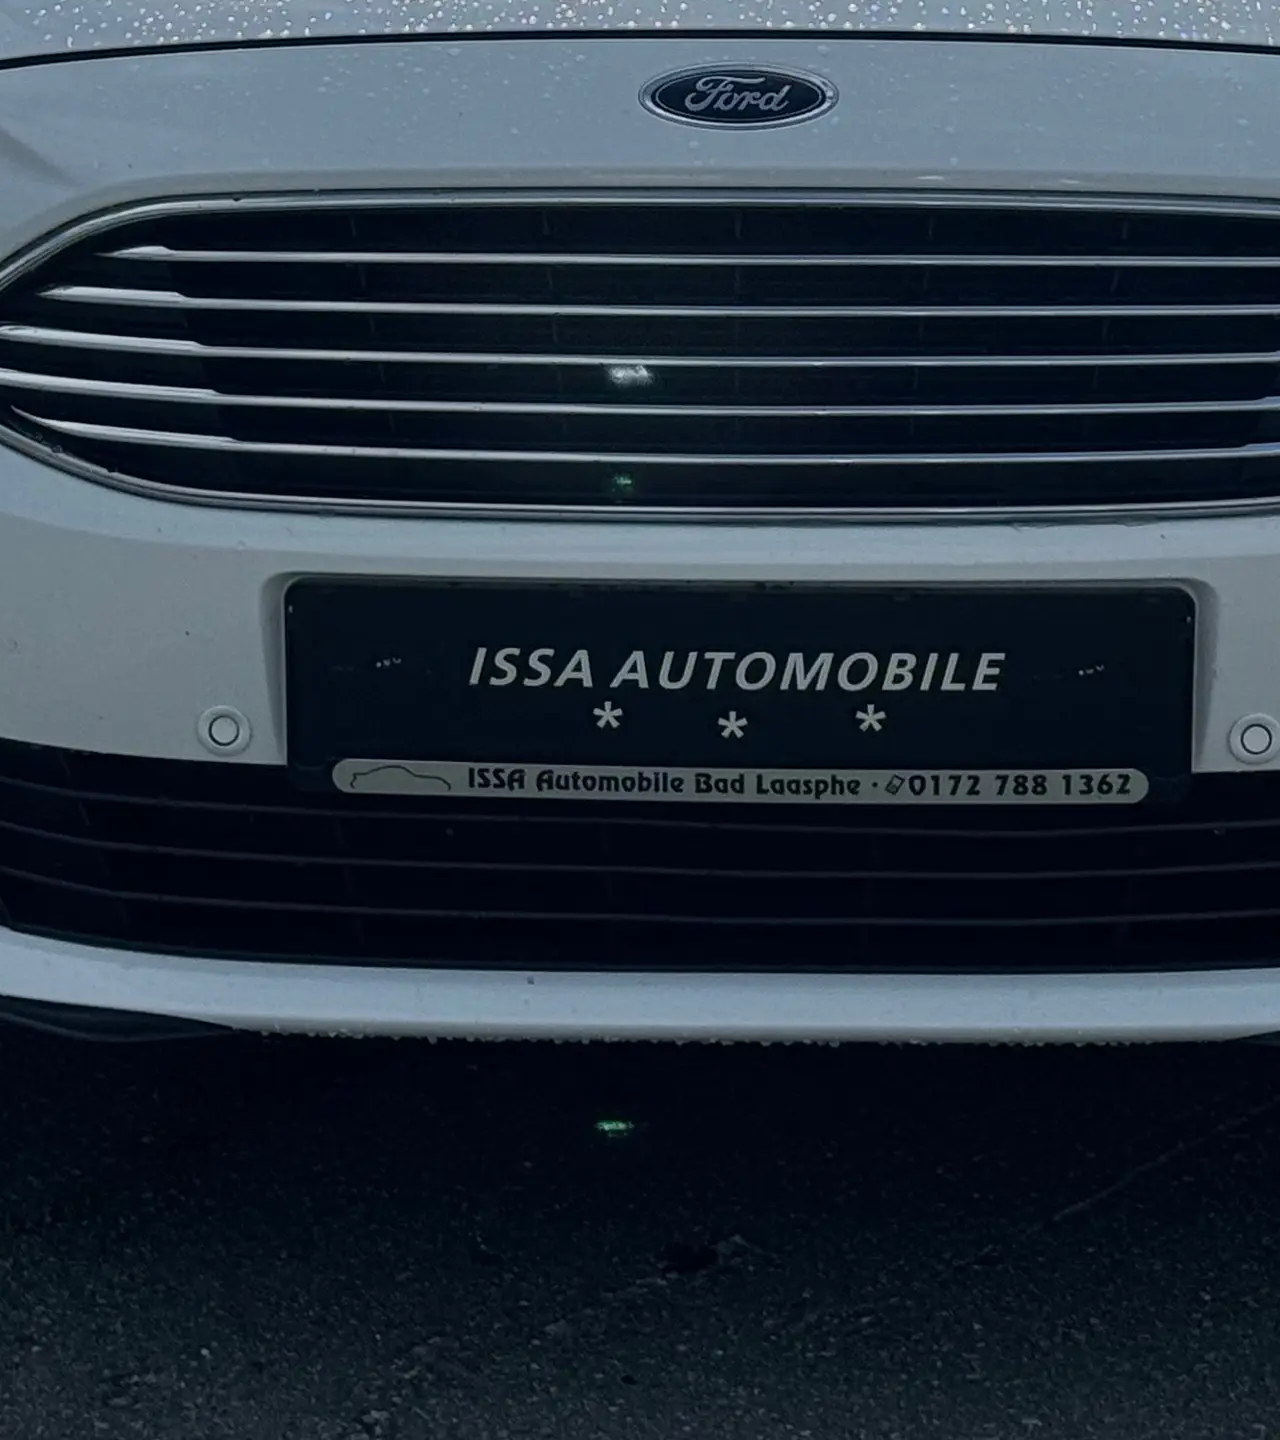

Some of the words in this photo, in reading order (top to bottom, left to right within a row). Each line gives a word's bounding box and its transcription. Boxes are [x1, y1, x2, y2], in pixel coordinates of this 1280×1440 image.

[684, 75, 792, 112] Ford
[468, 646, 594, 688] ISSA
[609, 649, 1006, 692] AUTOMOBILE
[467, 766, 526, 792] ISSA
[535, 768, 685, 794] Automobile
[694, 771, 745, 795] Bad
[756, 773, 861, 800] Laasphe
[907, 774, 981, 796] 0172
[995, 774, 1049, 796] 788
[1062, 773, 1132, 796] 1362
